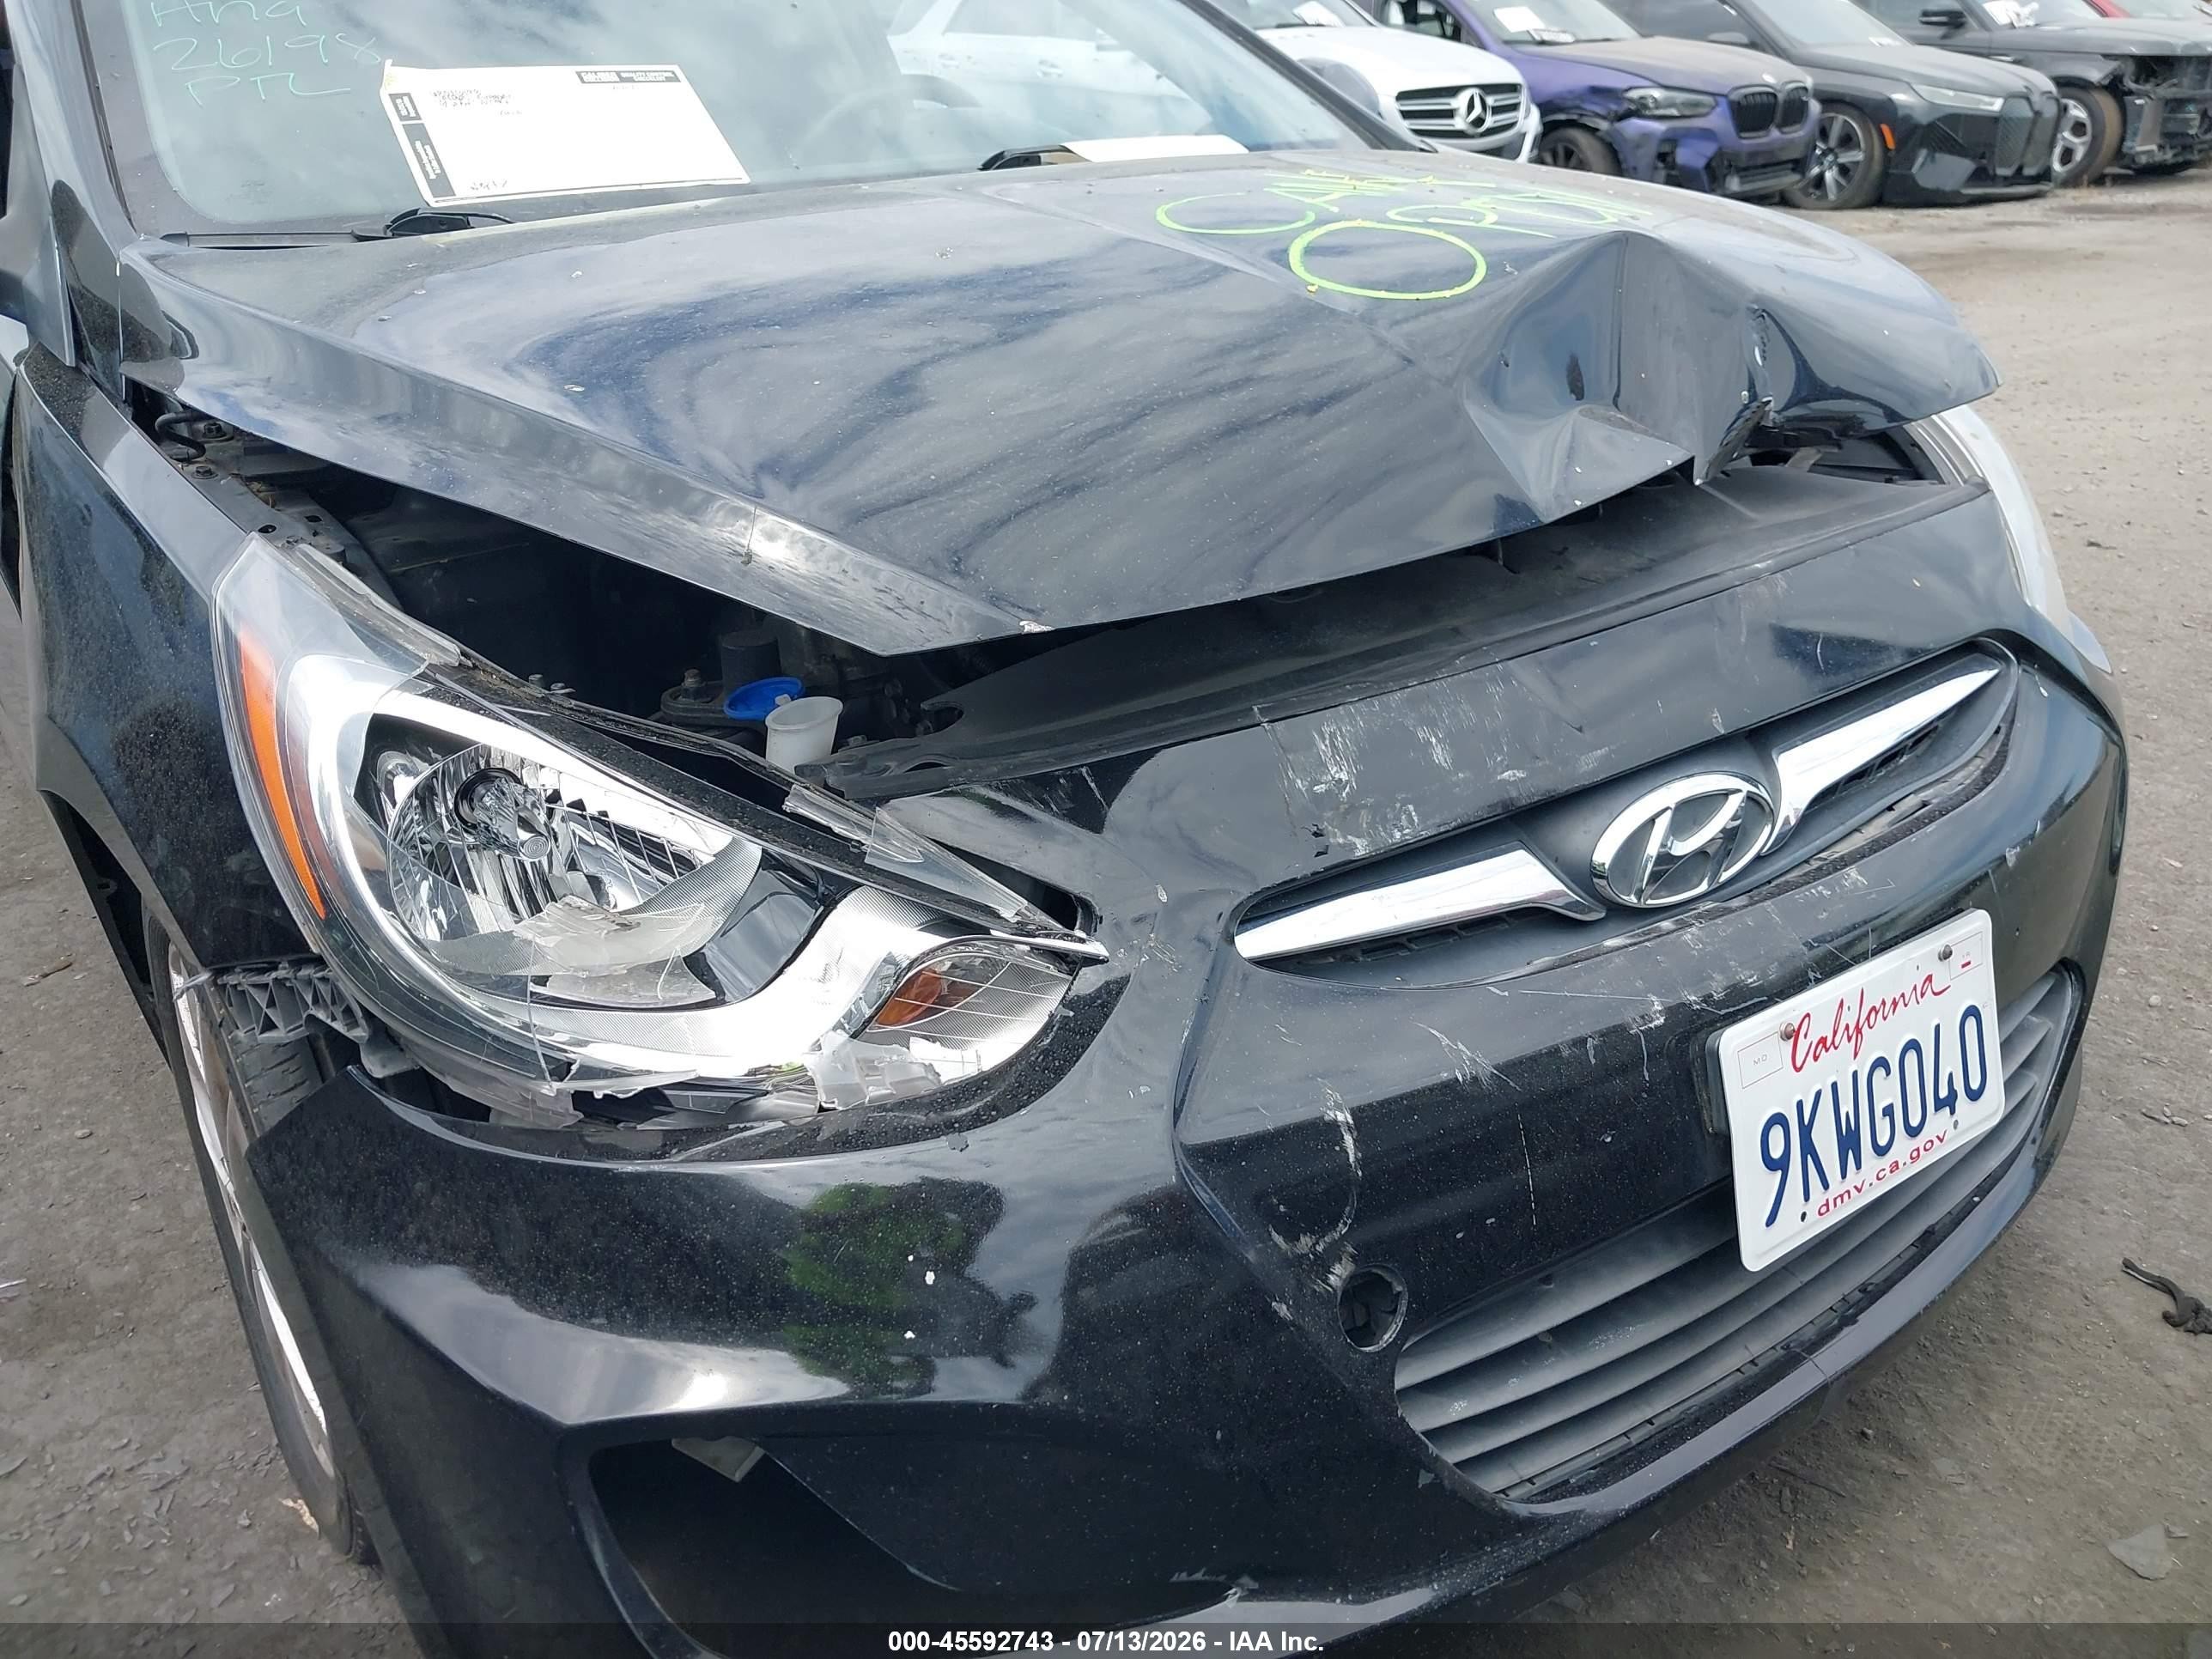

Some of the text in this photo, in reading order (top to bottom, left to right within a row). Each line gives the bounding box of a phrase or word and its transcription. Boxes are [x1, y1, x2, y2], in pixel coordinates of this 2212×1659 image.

[1790, 970, 1951, 1073] California
[1760, 1004, 1988, 1228] 9KWG040
[1816, 1129, 1949, 1218] dmv.ca.gov
